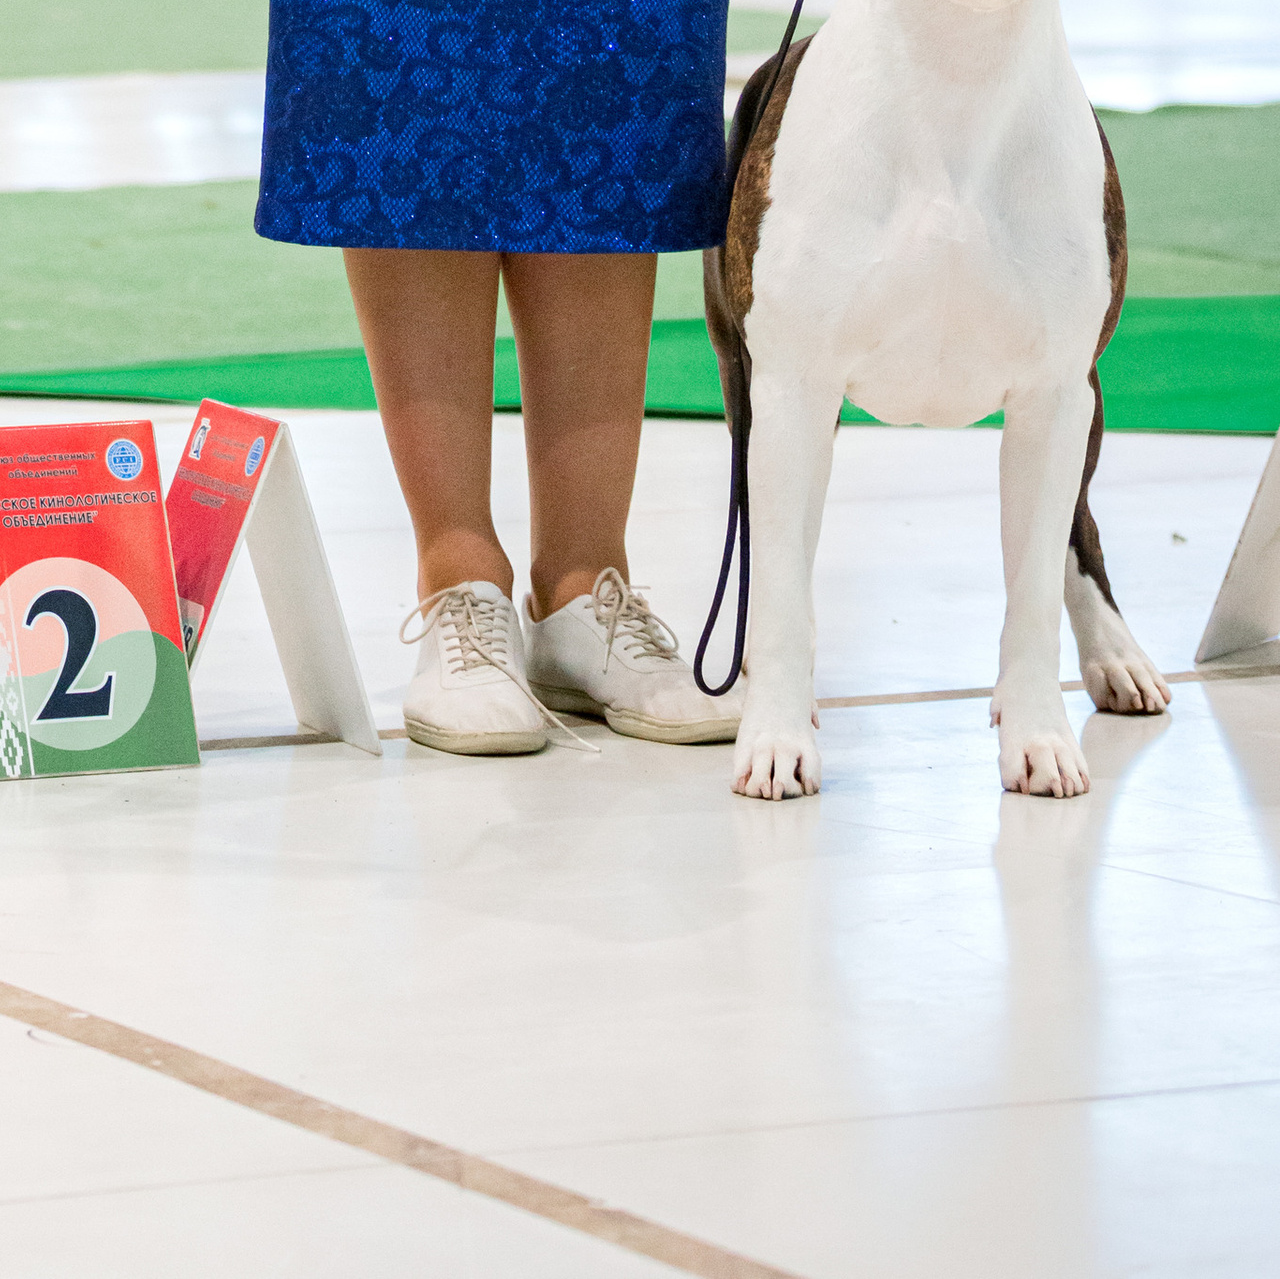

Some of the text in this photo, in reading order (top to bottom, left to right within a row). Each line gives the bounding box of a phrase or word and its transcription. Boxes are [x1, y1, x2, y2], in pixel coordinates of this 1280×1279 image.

[16, 451, 96, 463] общественных
[8, 466, 78, 480] объединений
[39, 490, 157, 509] КИНОЛОГИЧЕСКОЕ
[2, 511, 99, 529] ОБЪЕДИНЕНИЕ"
[23, 586, 116, 723] 2
